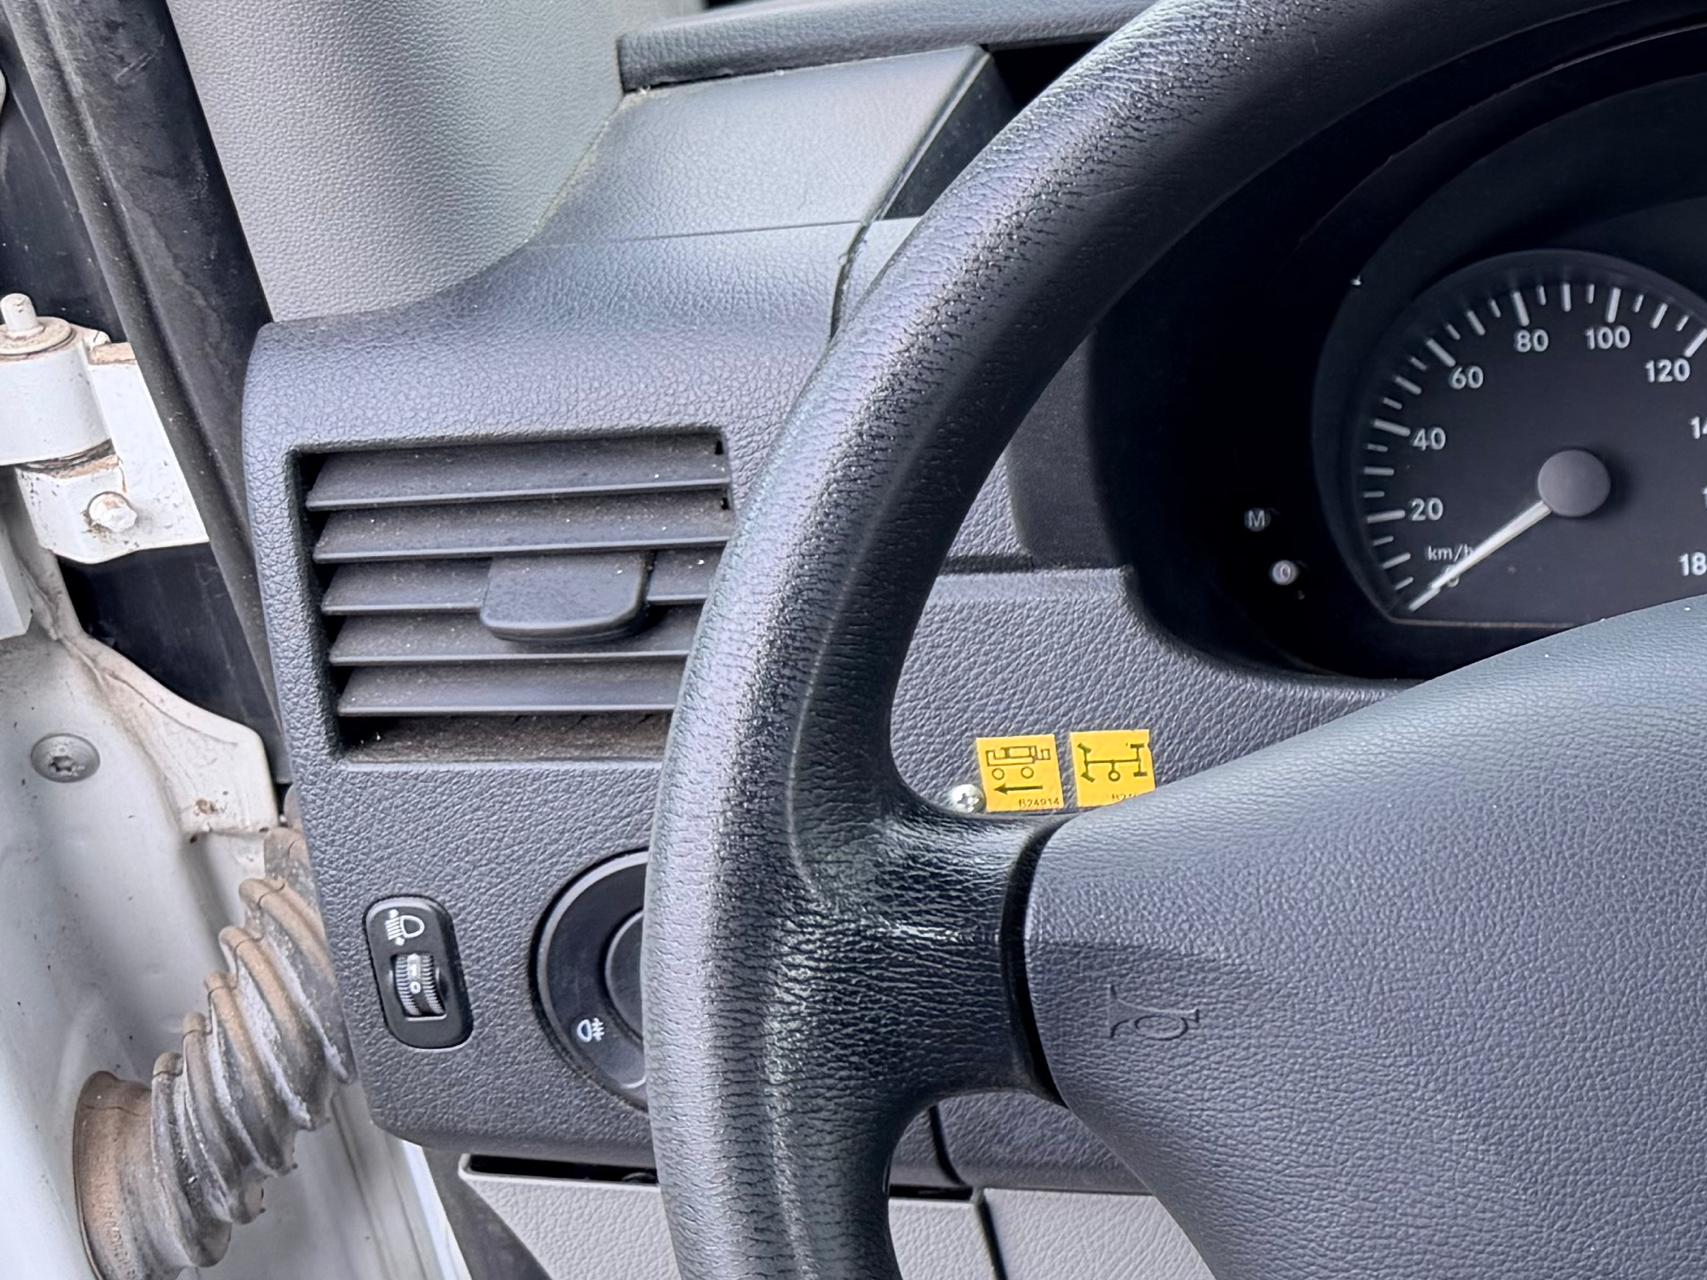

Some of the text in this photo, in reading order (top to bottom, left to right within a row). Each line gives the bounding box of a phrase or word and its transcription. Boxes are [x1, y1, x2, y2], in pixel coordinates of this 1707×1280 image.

[1514, 330, 1549, 353] 80
[1586, 327, 1631, 350] 100
[1450, 366, 1484, 390] 60
[1645, 359, 1691, 384] 120
[1413, 427, 1447, 452] 40
[1247, 509, 1266, 529] M
[1410, 498, 1444, 521] 20
